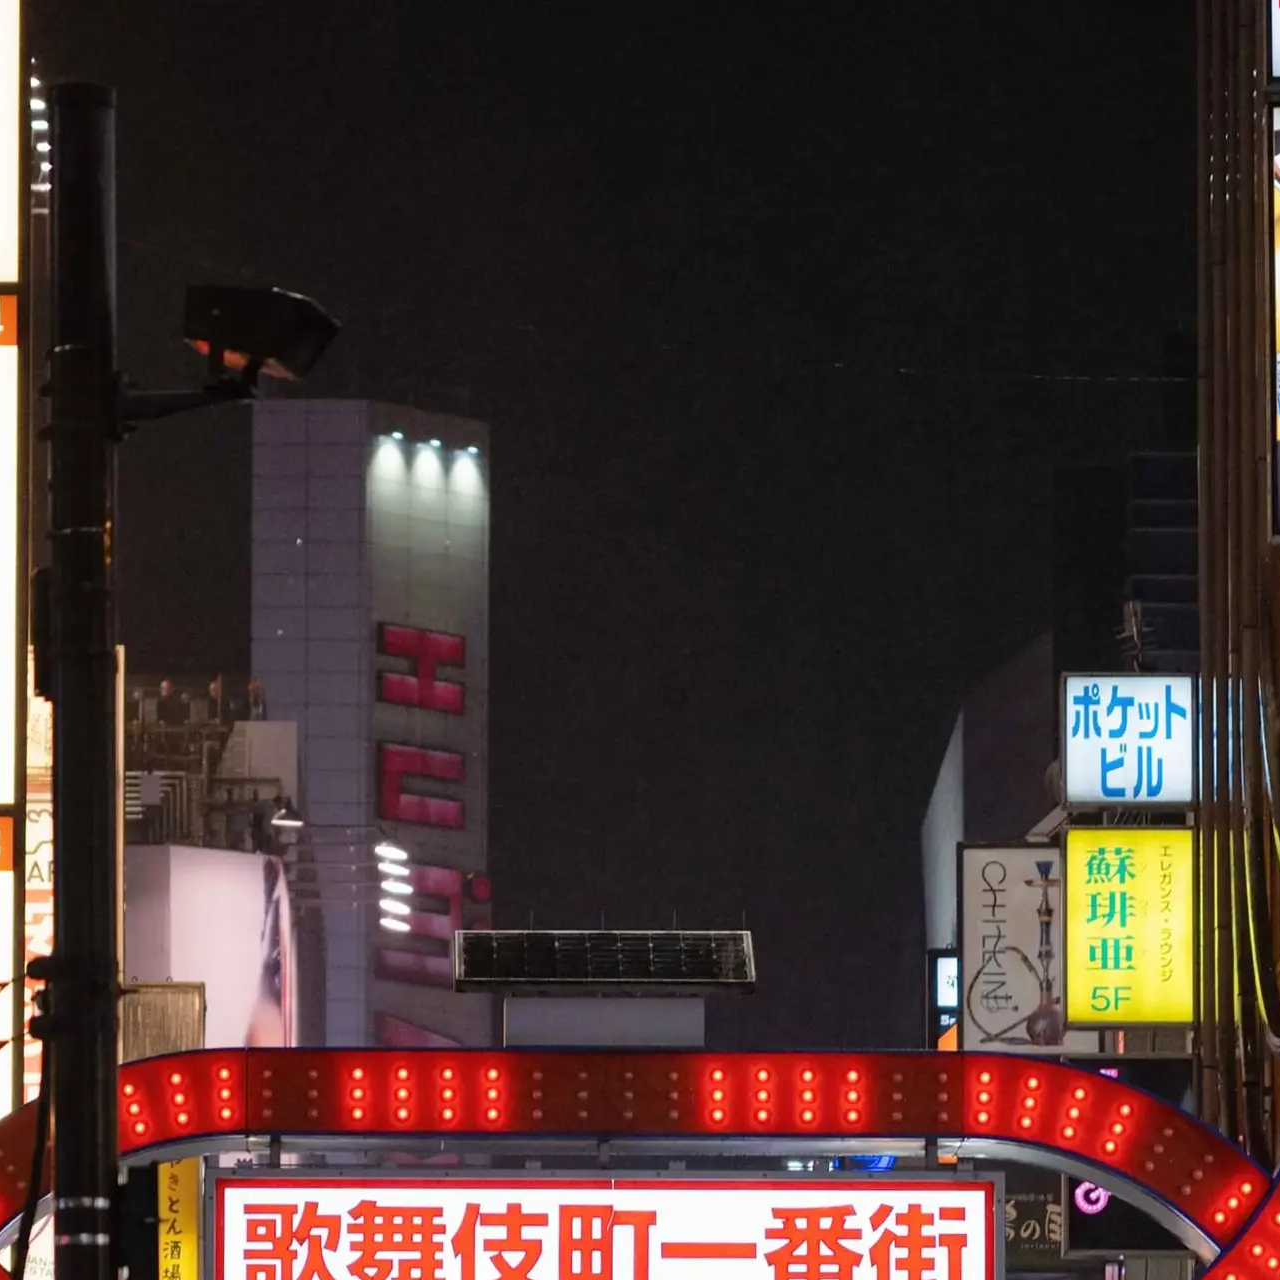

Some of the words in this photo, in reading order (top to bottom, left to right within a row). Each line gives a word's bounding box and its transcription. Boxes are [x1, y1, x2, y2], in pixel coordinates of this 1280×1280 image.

[1072, 683, 1187, 740] ポケット
[1101, 746, 1162, 798] ビル
[1090, 986, 1132, 1012] 5F
